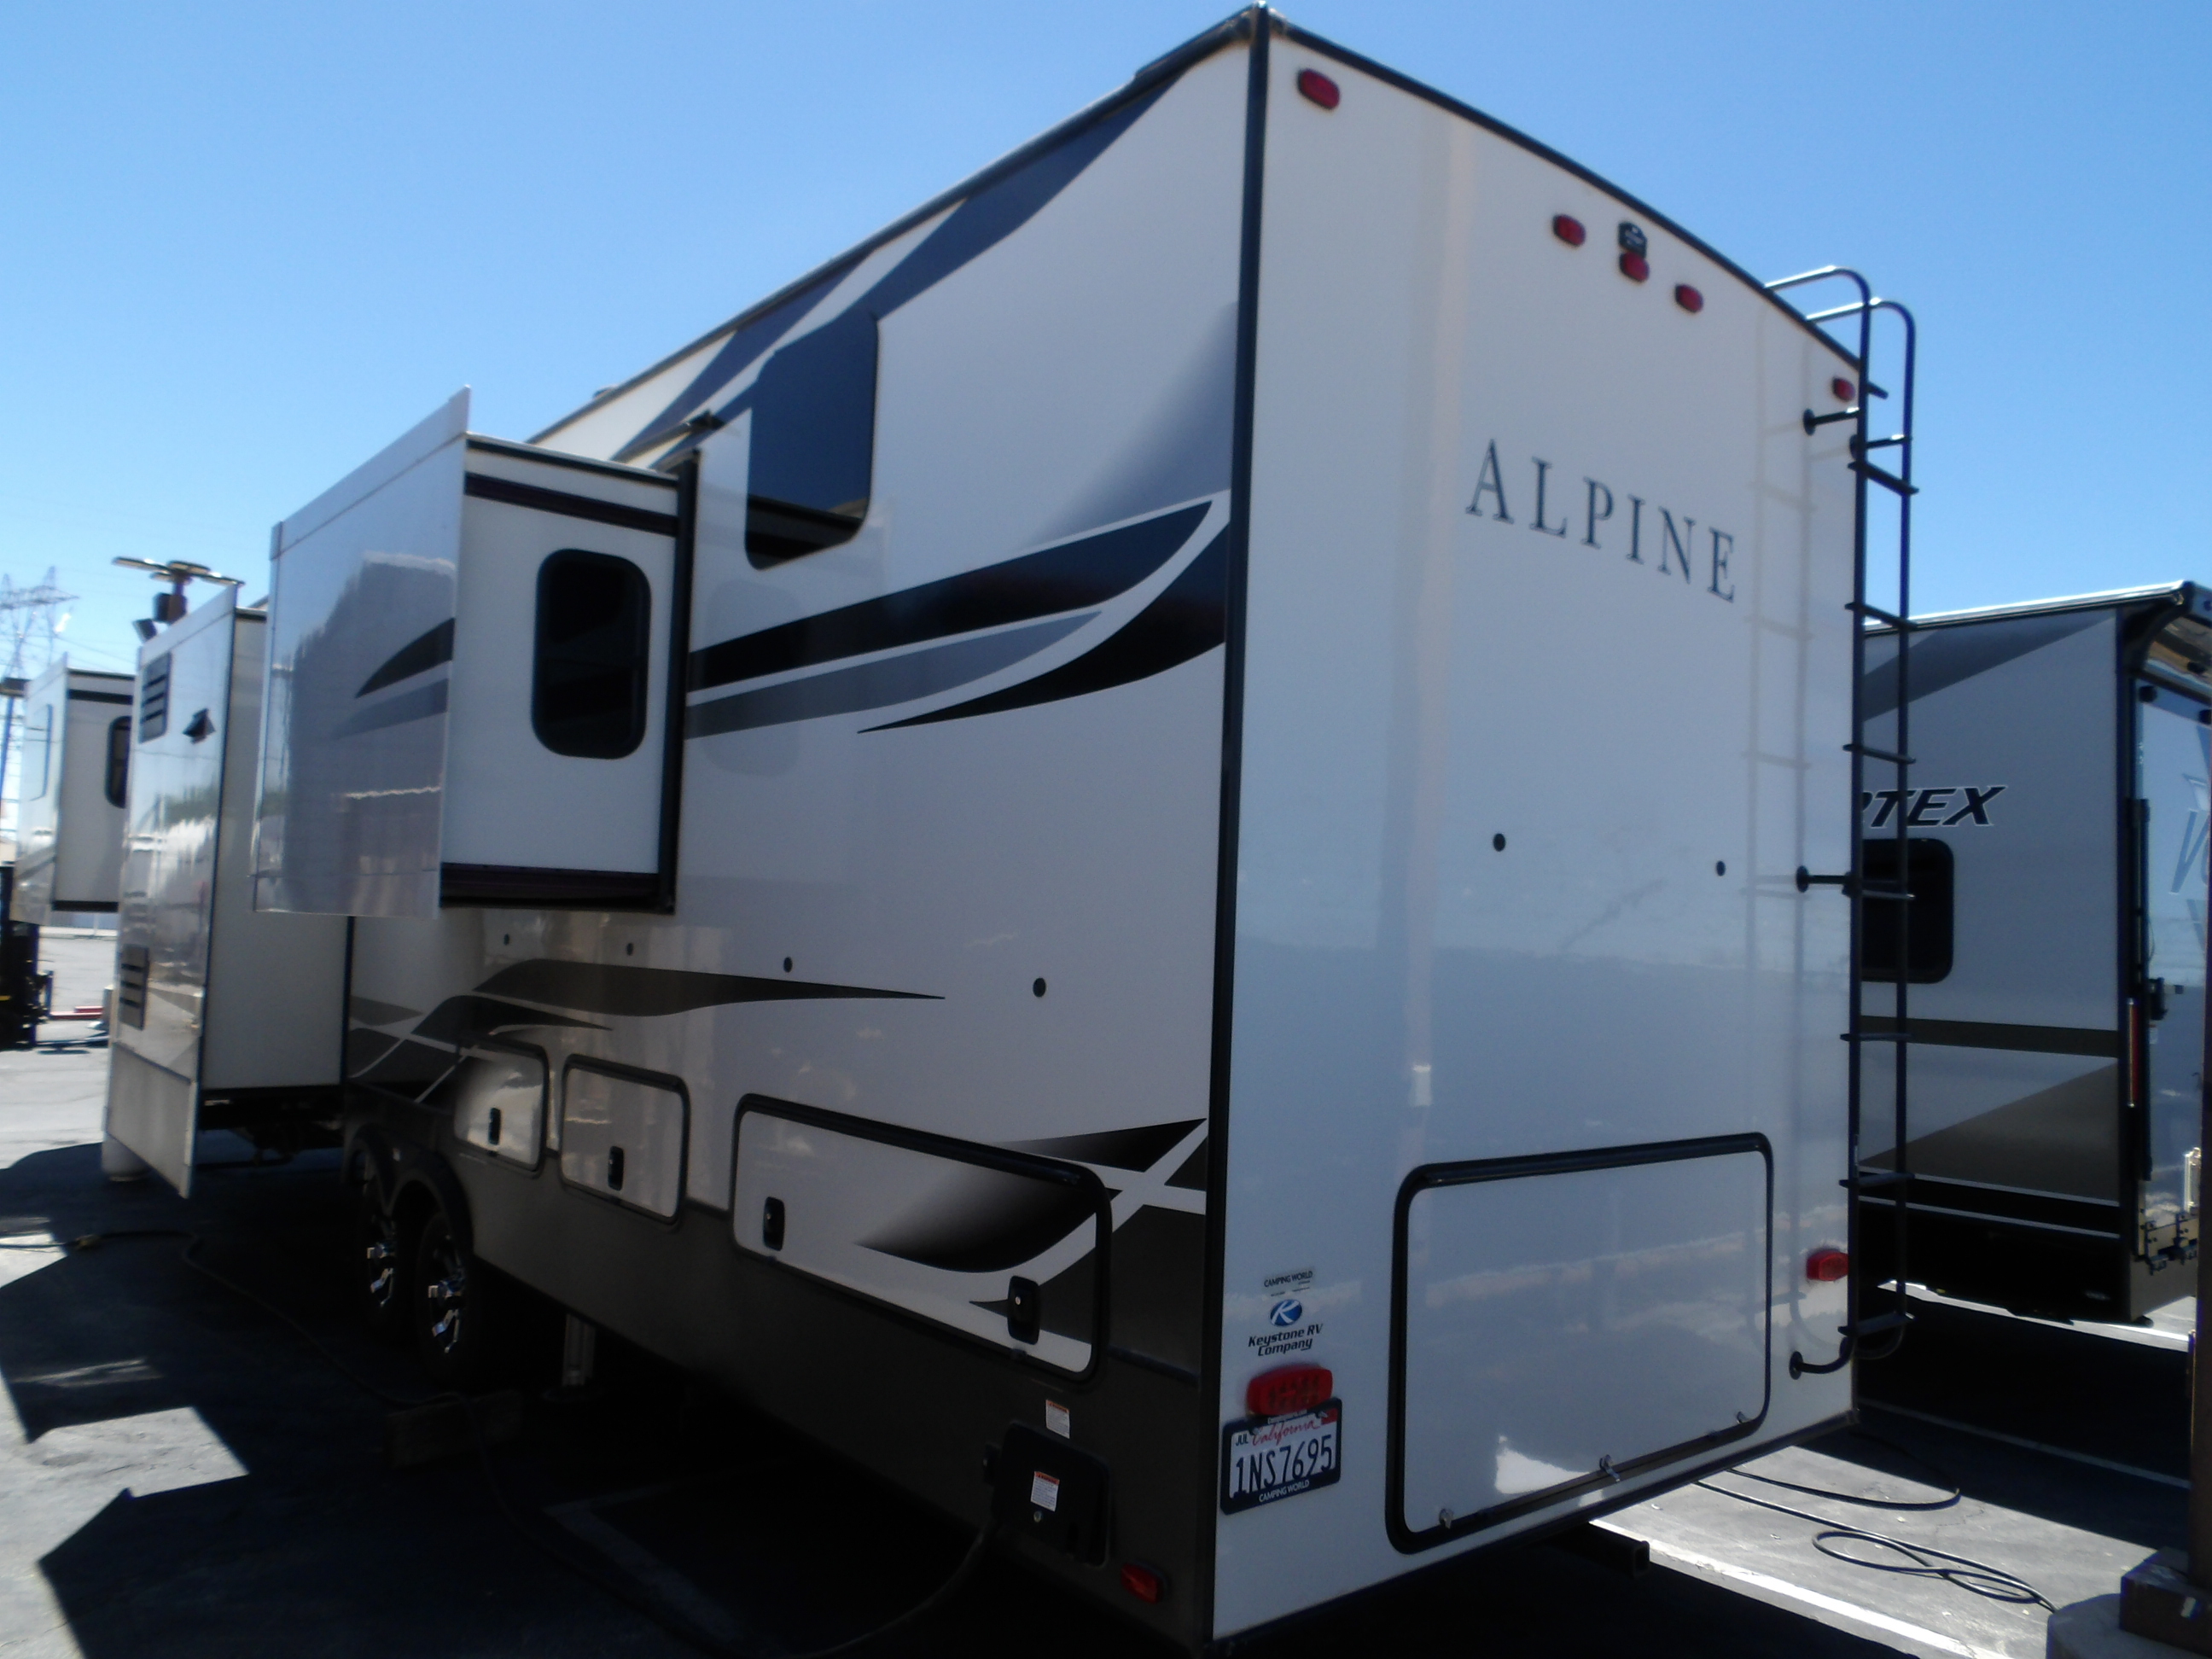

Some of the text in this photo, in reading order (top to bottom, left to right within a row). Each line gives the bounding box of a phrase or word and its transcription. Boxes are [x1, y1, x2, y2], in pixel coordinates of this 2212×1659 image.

[1465, 439, 1734, 603] ALPINE
[1860, 784, 2009, 829] TEX
[1264, 1275, 1291, 1288] CAMPING
[1291, 1270, 1313, 1282] WORLD
[1248, 1323, 1324, 1348] Keystone RV
[1257, 1338, 1313, 1357] Company
[1235, 1418, 1321, 1447] JUL California
[1235, 1434, 1332, 1493] 1NS7695
[1259, 1479, 1310, 1503] CAMPING WORLD
